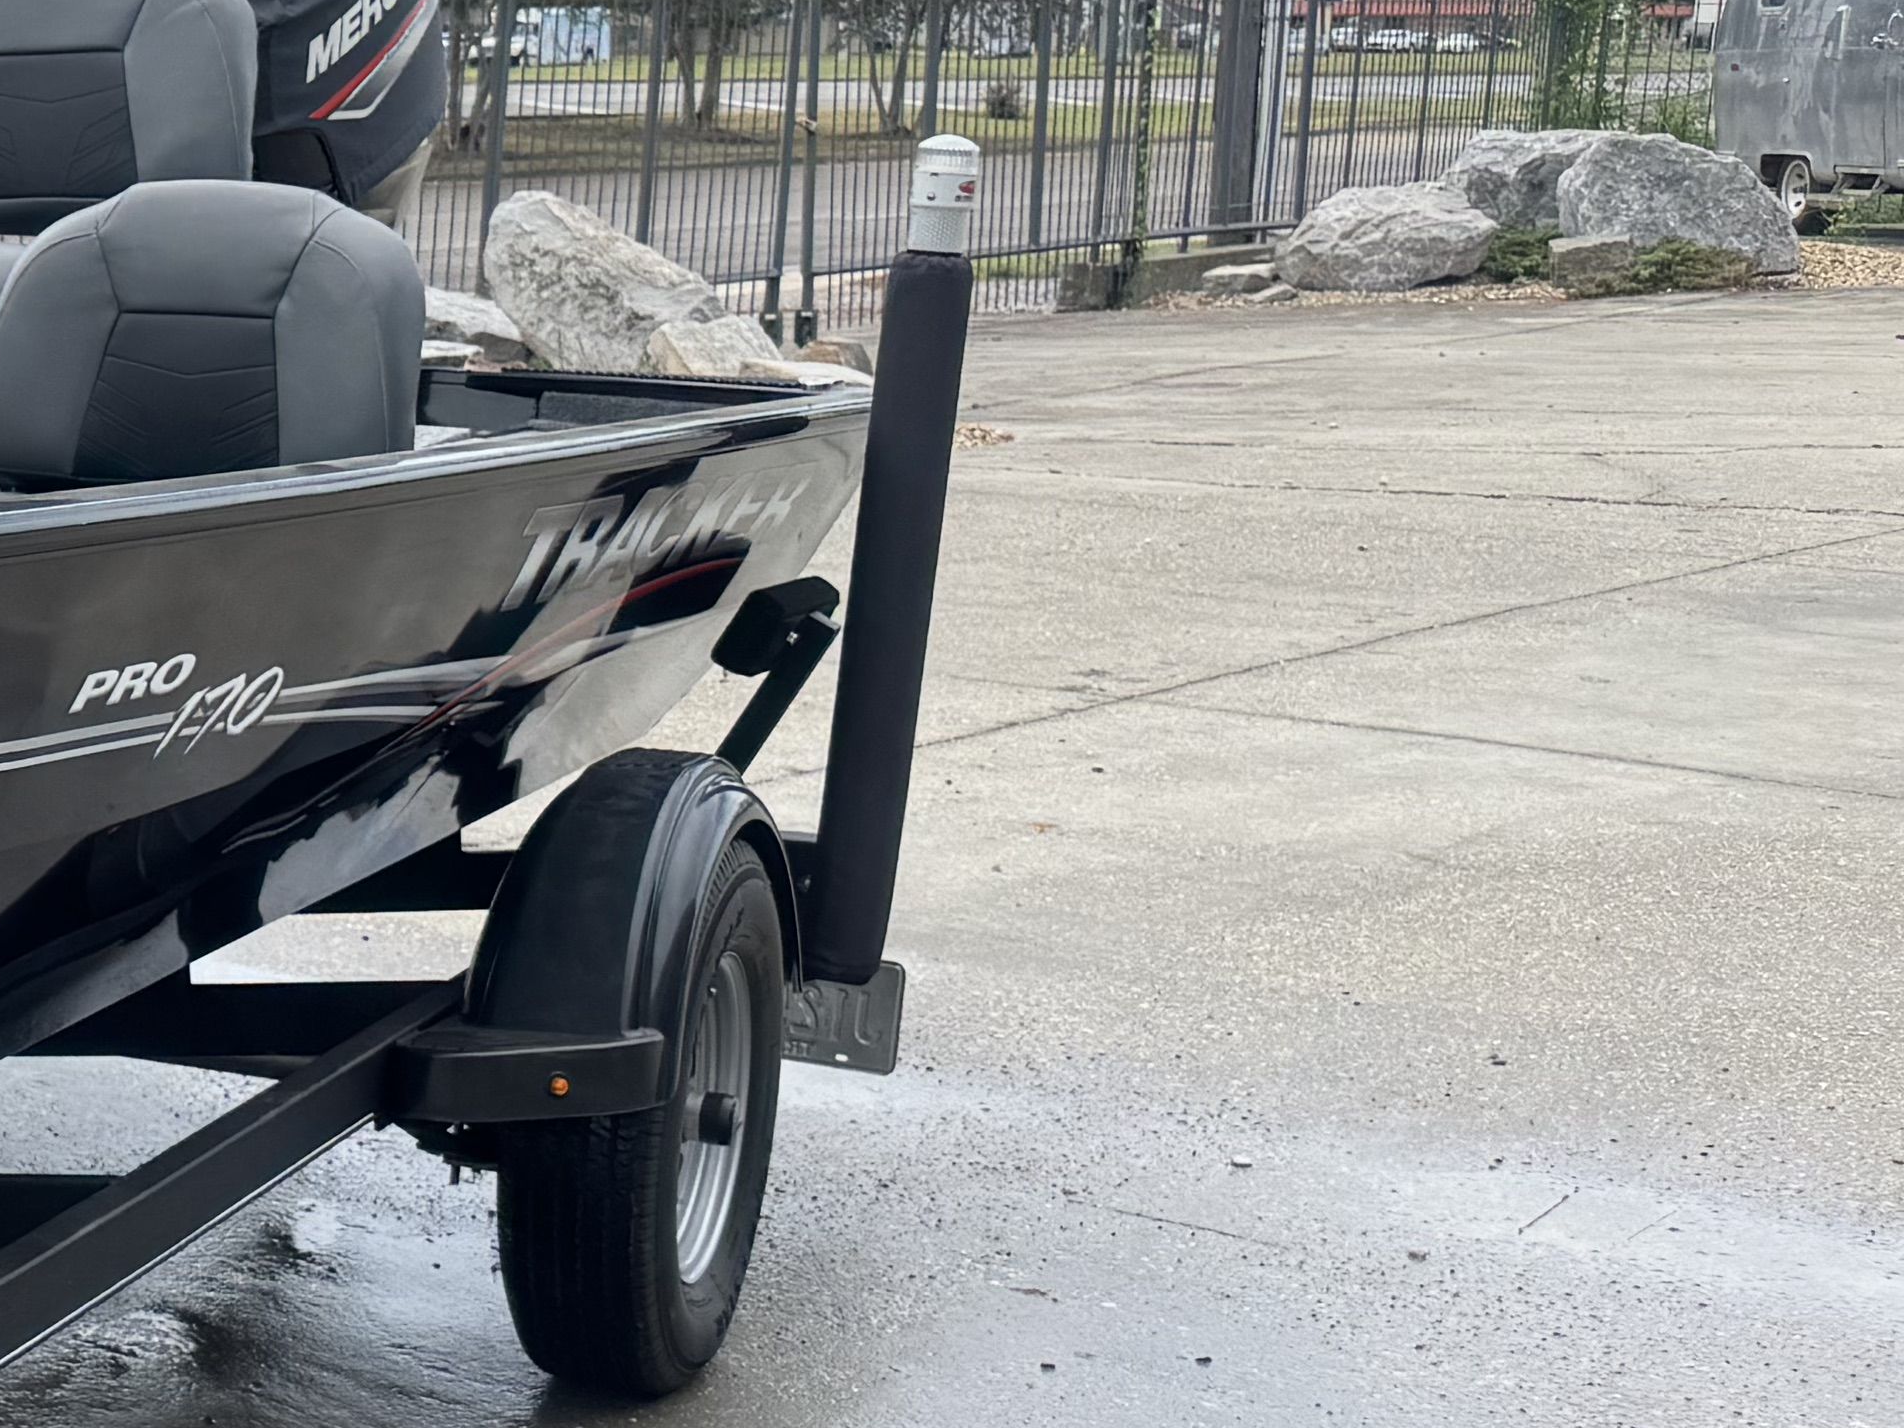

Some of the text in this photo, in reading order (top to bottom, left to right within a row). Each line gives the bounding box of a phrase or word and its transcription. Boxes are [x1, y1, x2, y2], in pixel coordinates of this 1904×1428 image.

[500, 461, 821, 612] TRACKER
[68, 653, 196, 714] PRO
[153, 666, 284, 759] 170
